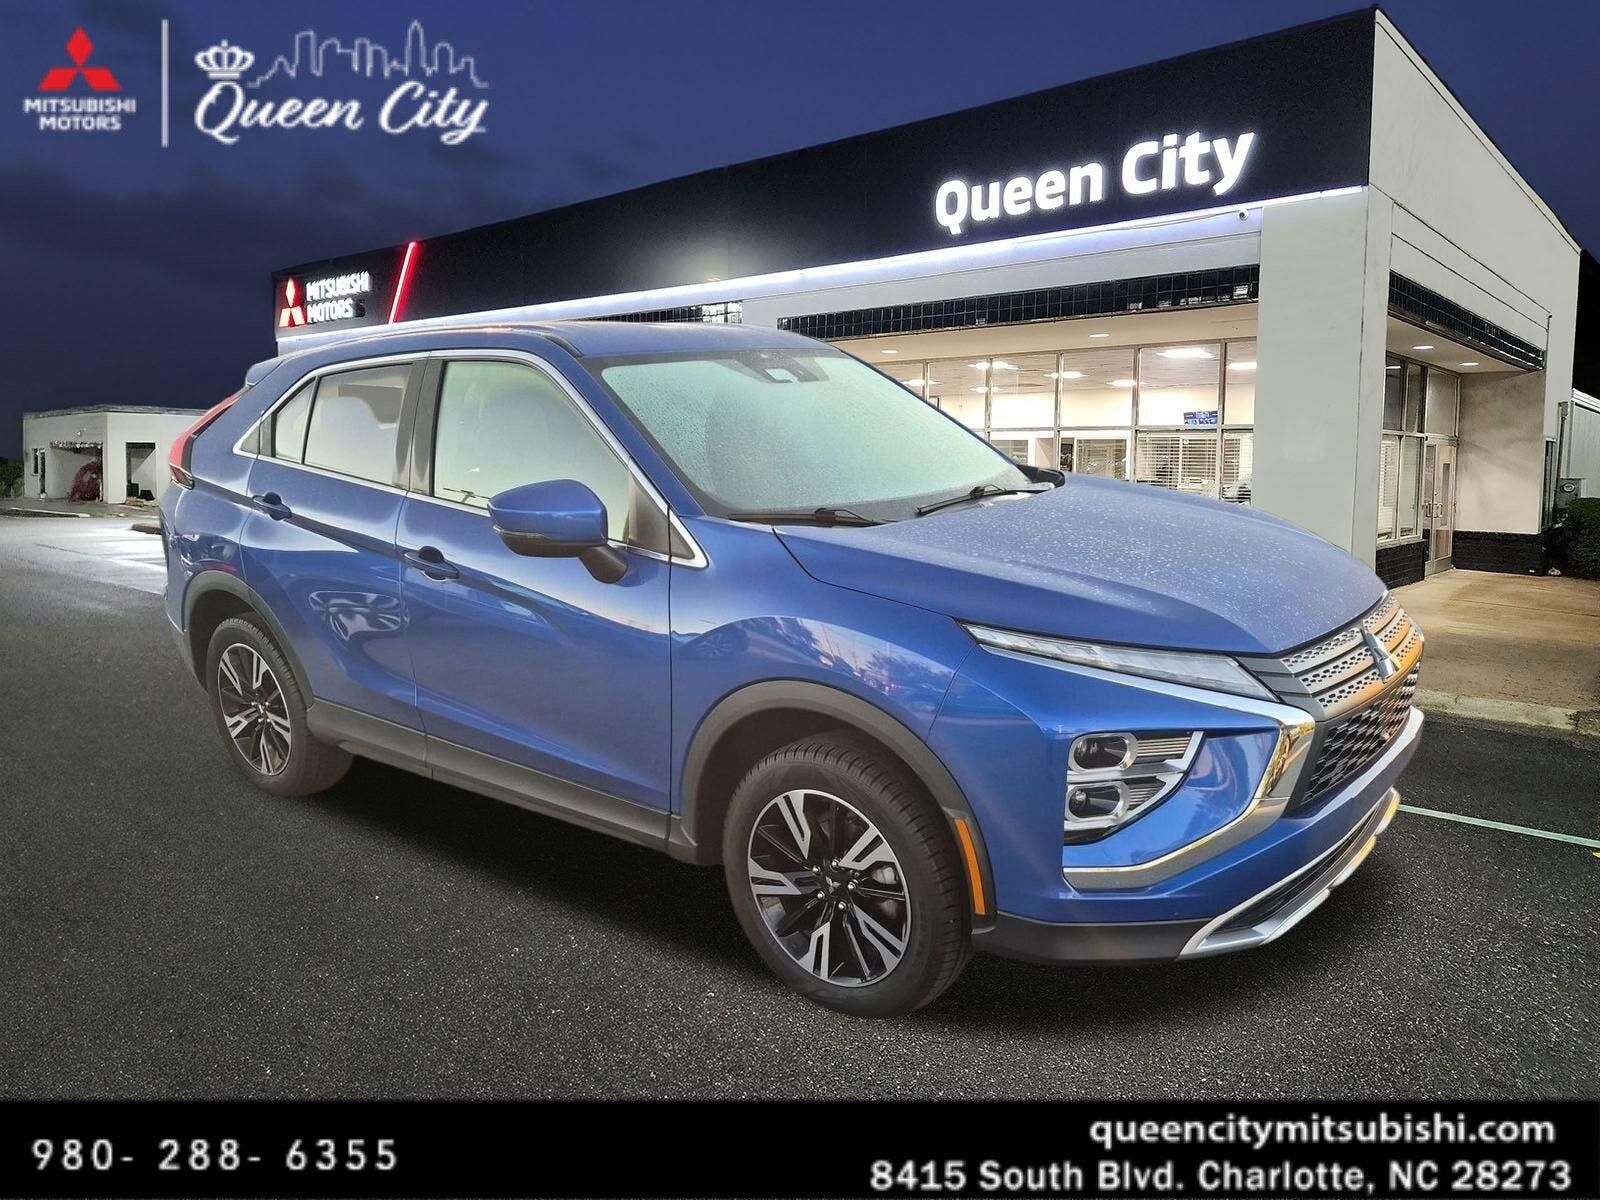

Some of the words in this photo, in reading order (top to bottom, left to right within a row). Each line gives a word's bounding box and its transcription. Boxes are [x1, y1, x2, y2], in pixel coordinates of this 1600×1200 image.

[934, 161, 1104, 235] Queen
[1121, 131, 1256, 197] City
[305, 270, 371, 302] MITSUBISHI
[306, 297, 355, 324] MOTORS
